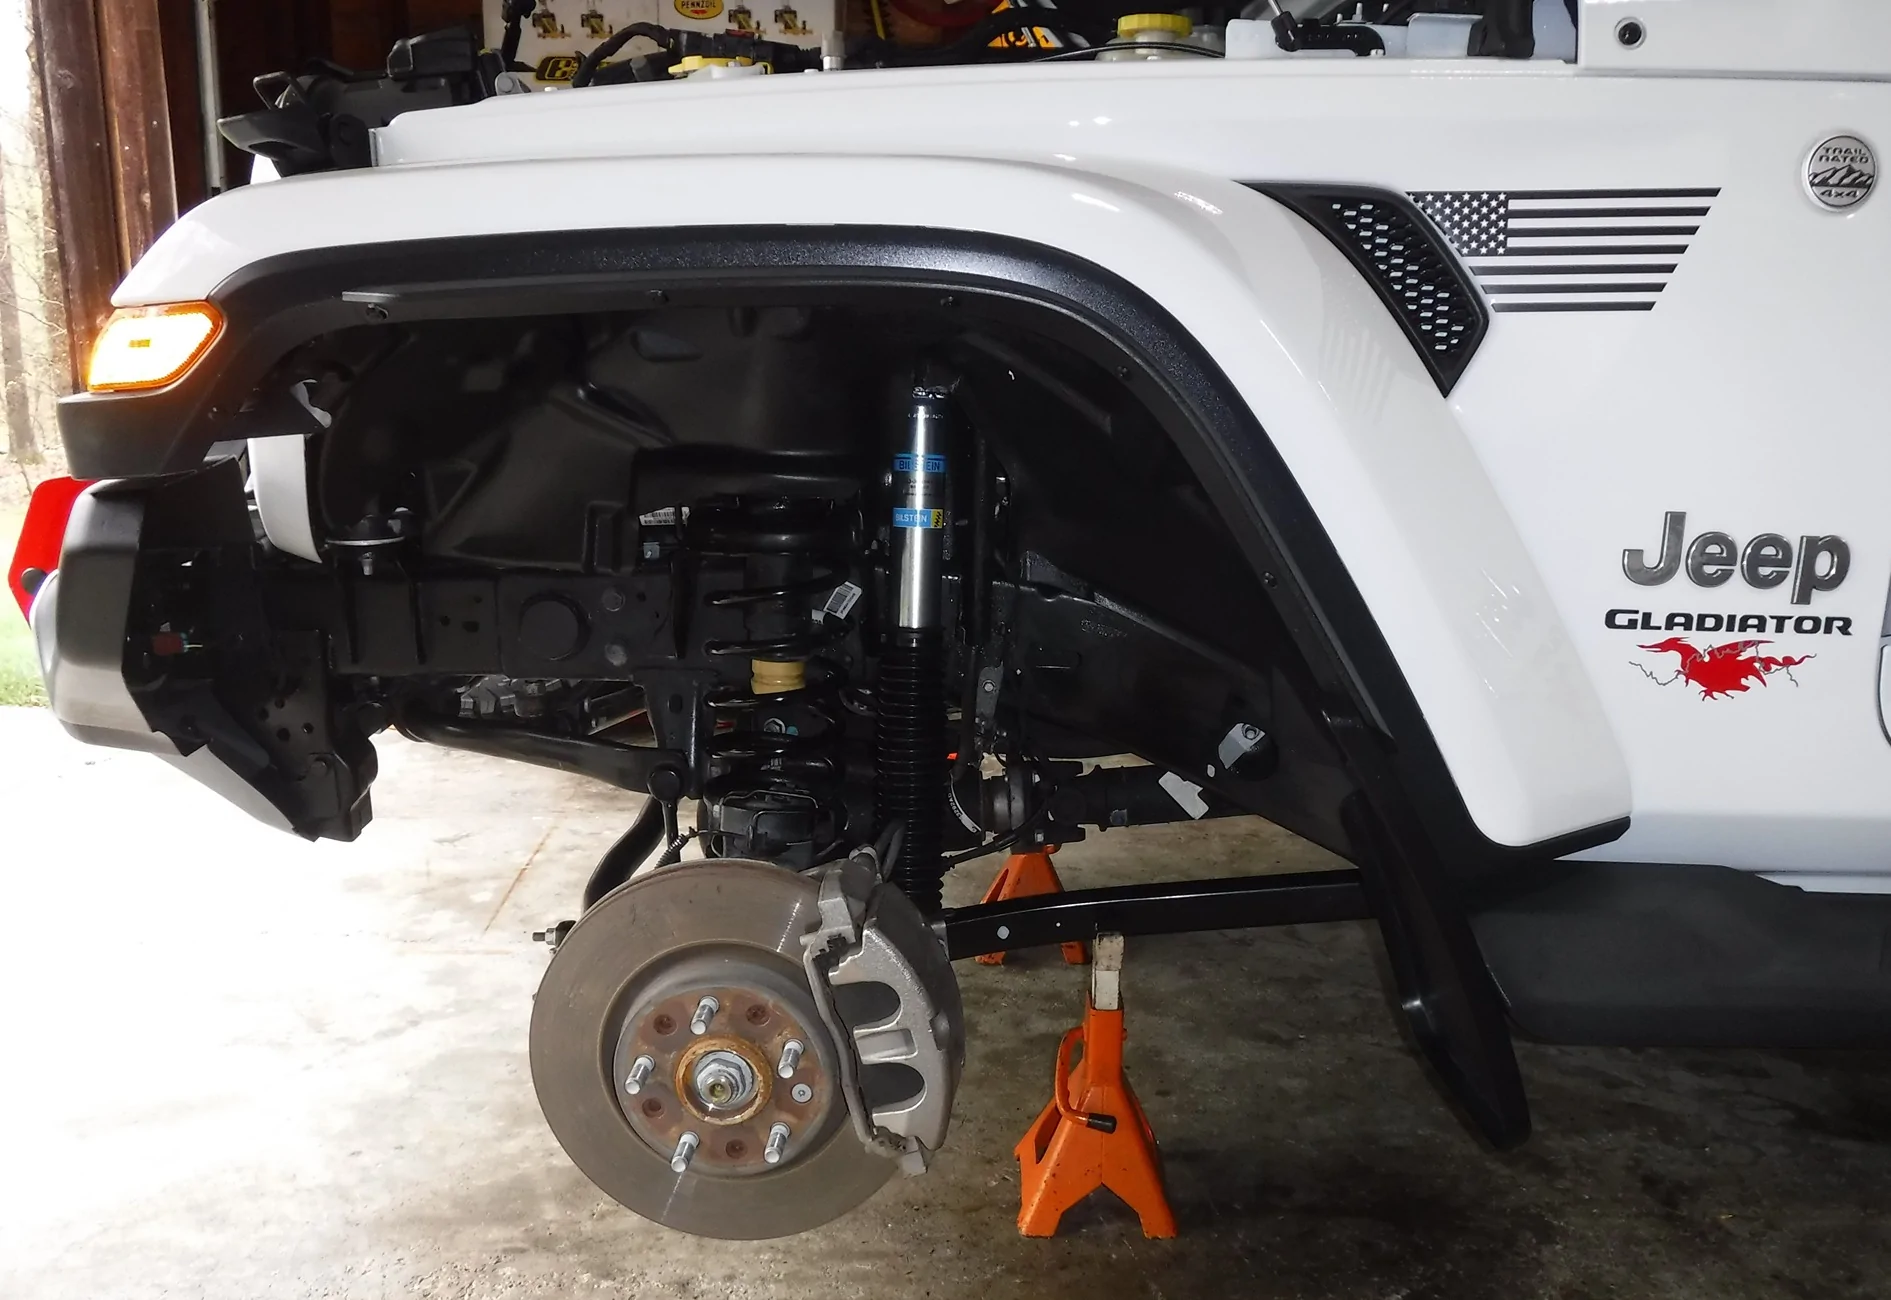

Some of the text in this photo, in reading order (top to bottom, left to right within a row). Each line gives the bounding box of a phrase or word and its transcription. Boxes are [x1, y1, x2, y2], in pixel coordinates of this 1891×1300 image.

[1823, 147, 1867, 155] TRAIL
[1819, 155, 1869, 163] RATED
[899, 460, 940, 470] BILEIN
[1622, 511, 1852, 605] Jeep
[1604, 608, 1853, 636] GLADIATOR
